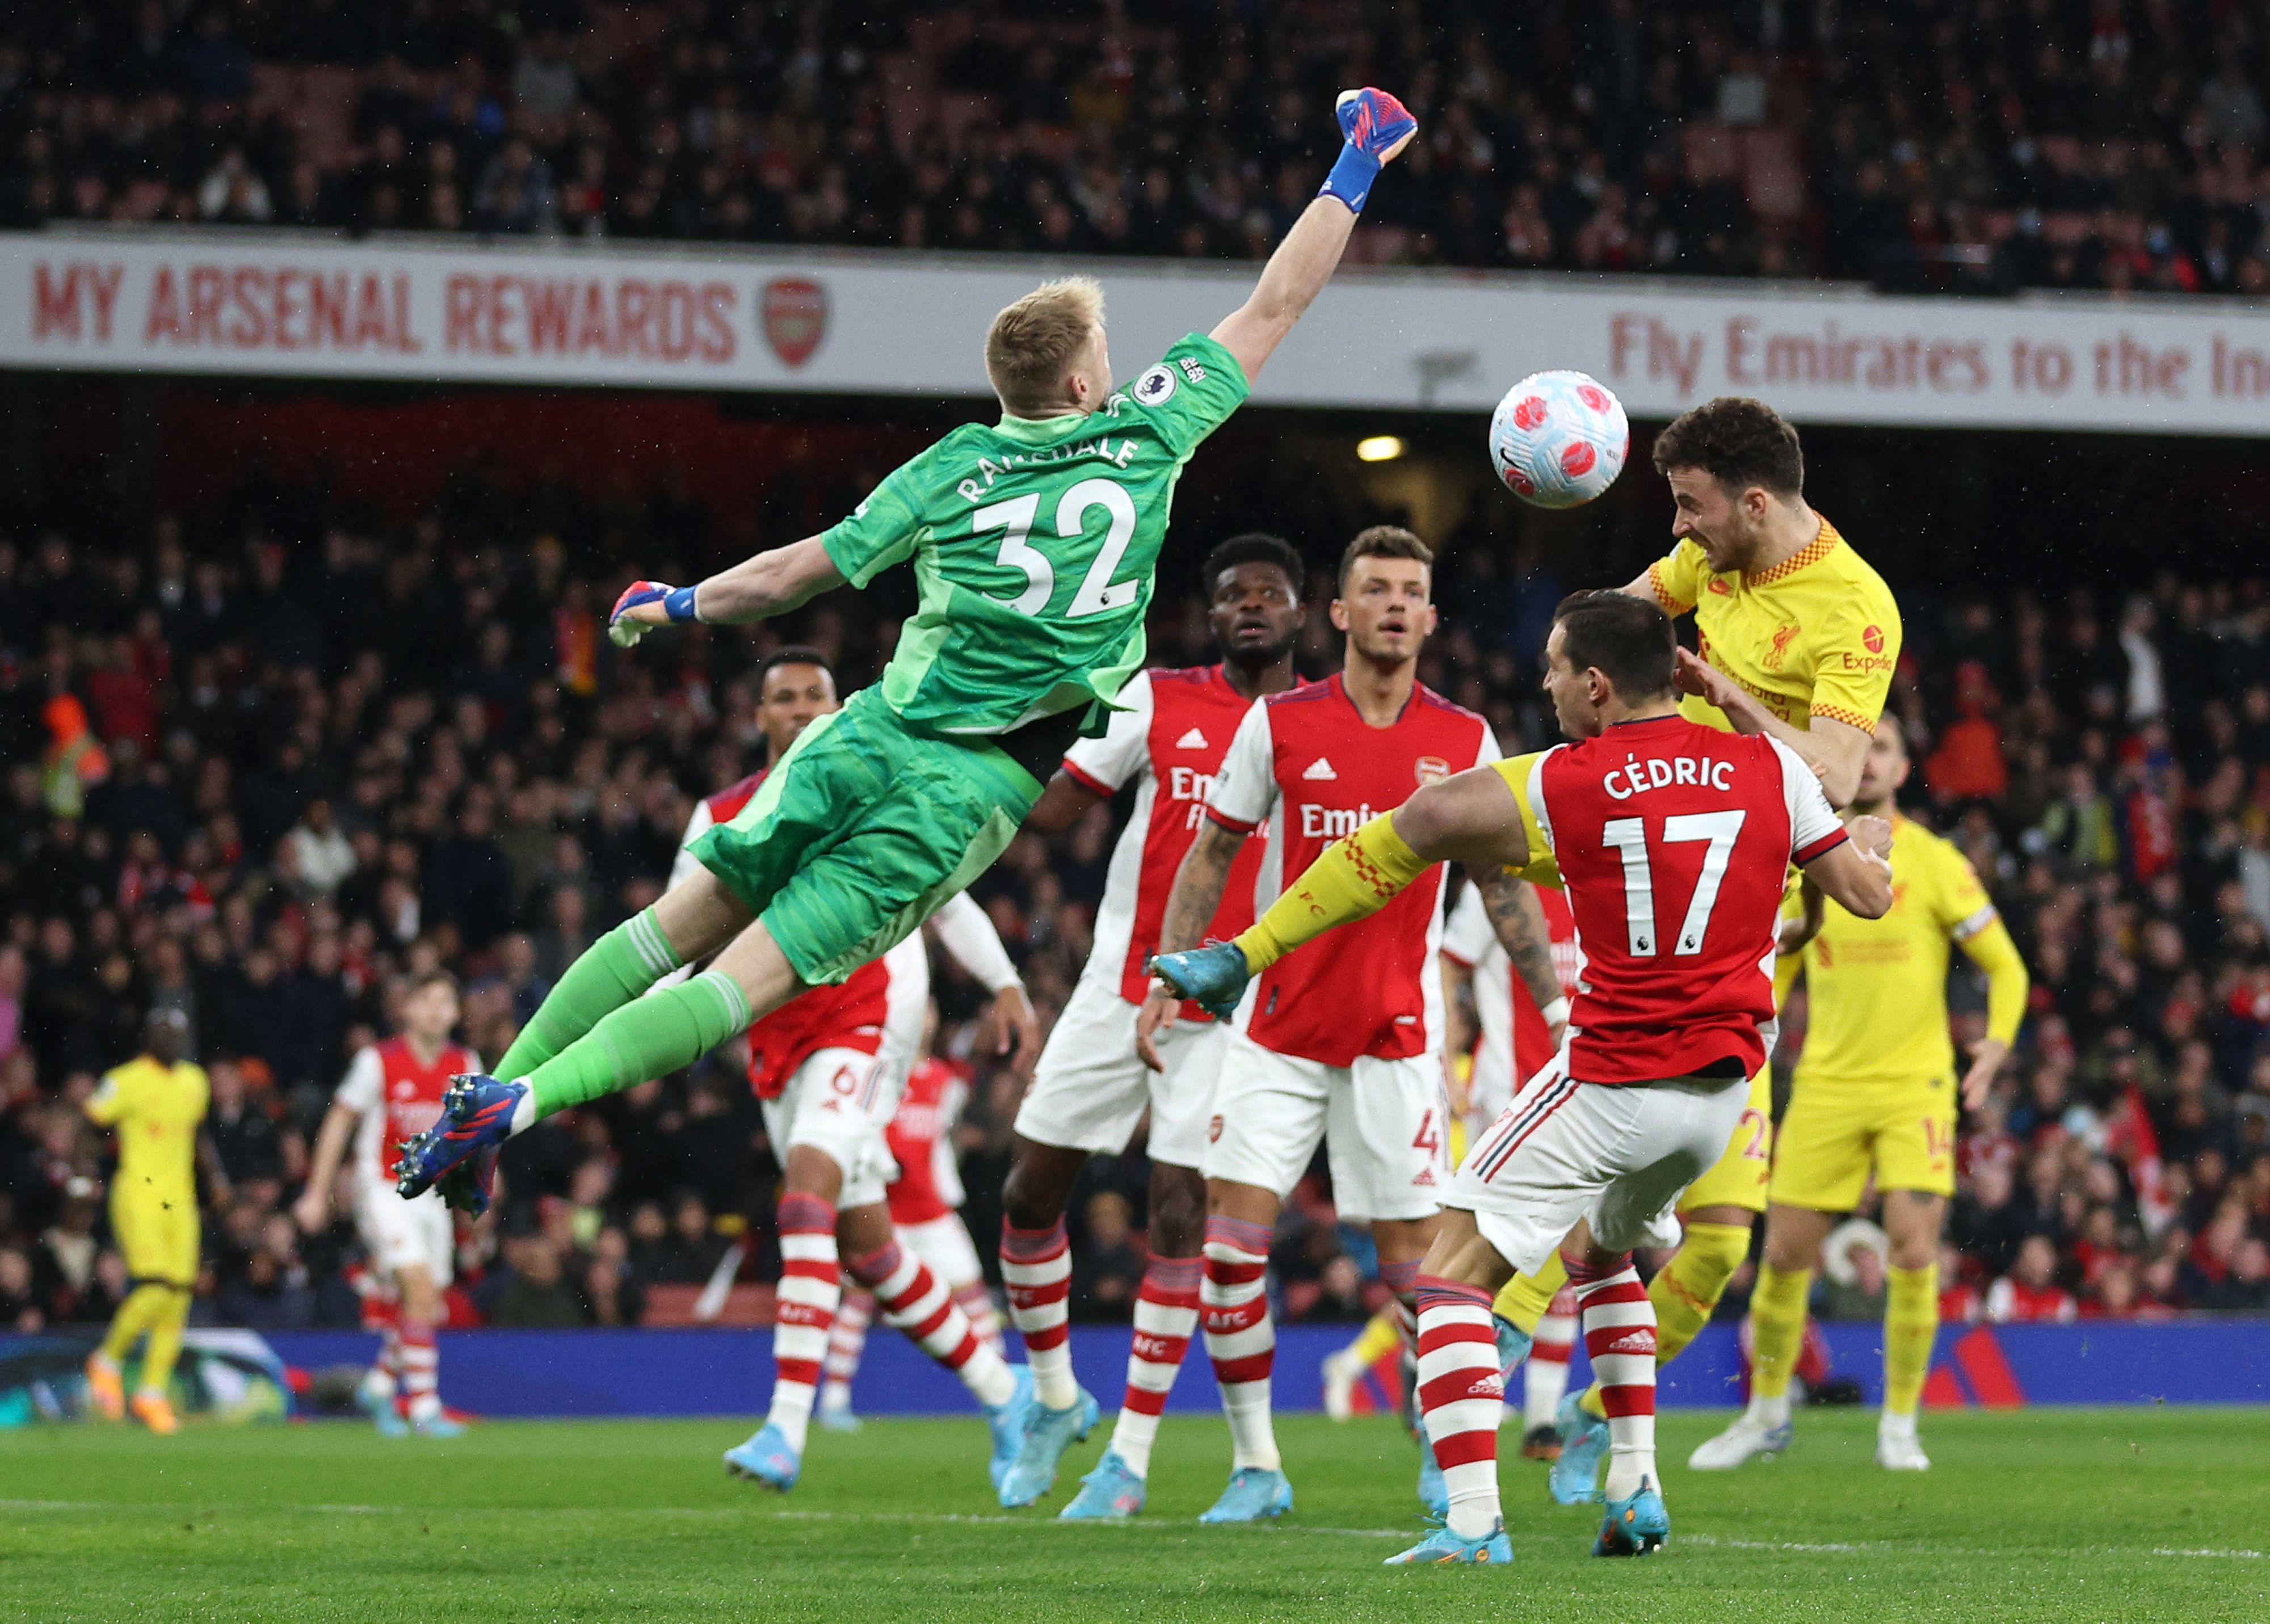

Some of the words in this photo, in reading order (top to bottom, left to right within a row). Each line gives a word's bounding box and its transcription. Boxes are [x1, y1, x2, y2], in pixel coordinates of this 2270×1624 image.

[32, 259, 125, 342] MY
[145, 262, 422, 352] ARSENAL
[443, 271, 738, 364] REWARDS
[1609, 311, 1705, 400] Fly
[1725, 313, 1989, 393] Emirates
[2011, 336, 2074, 396] to
[2094, 329, 2191, 399] the
[972, 478, 1140, 617] 32
[1603, 753, 1736, 800] CÉDRIC
[1601, 809, 1746, 957] 17
[832, 1064, 856, 1096] 6
[1412, 1109, 1438, 1160] 4
